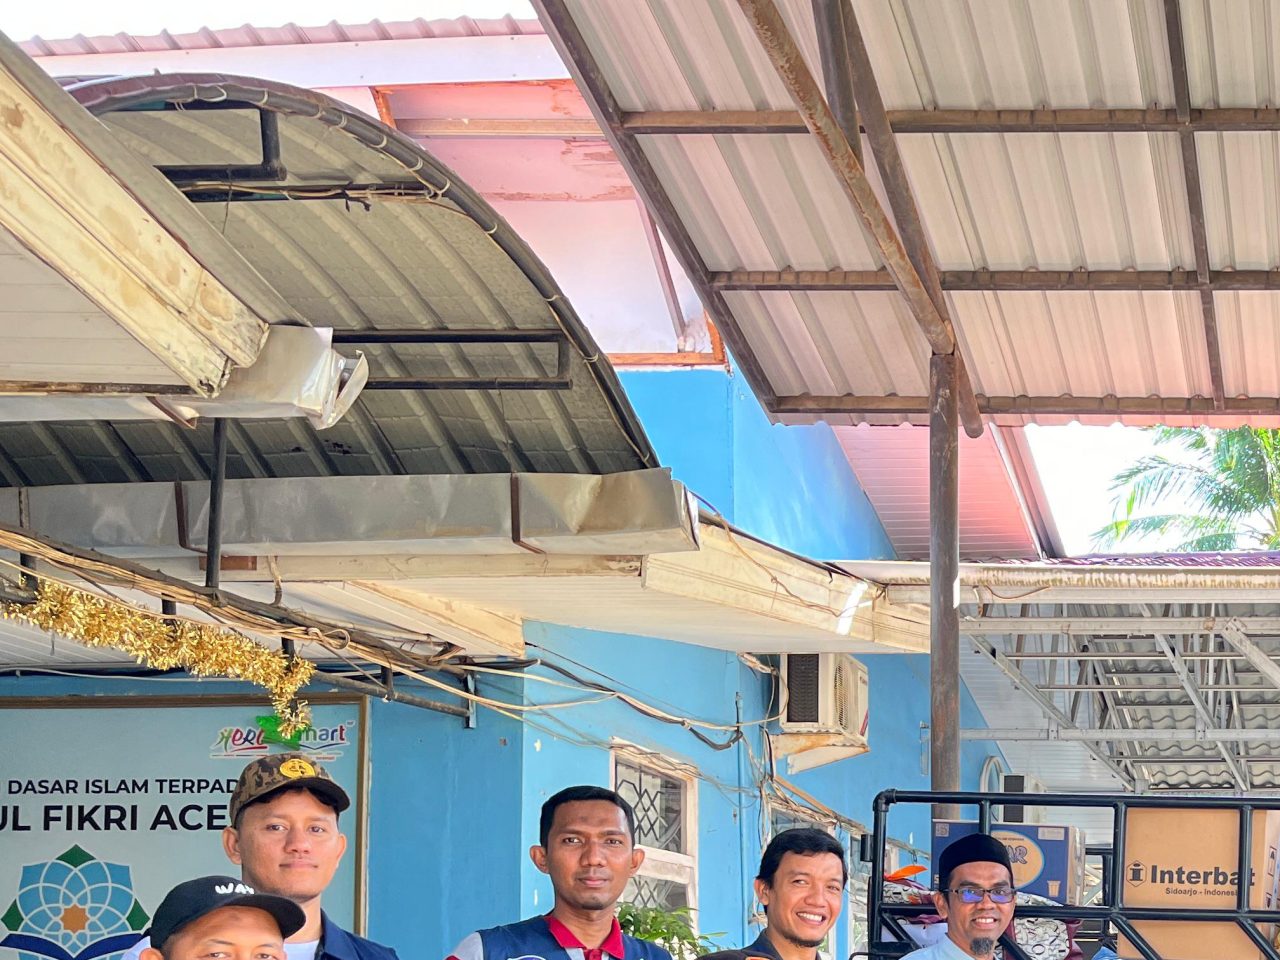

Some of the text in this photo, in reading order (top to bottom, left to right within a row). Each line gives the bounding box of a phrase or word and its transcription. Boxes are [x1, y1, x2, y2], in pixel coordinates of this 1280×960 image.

[8, 779, 79, 795] DASAR
[85, 779, 149, 794] ISLAM
[43, 804, 138, 831] FIKRI
[150, 804, 228, 831] ACE
[1151, 865, 1255, 887] Interbat
[1165, 887, 1198, 896] Sidoarjo
